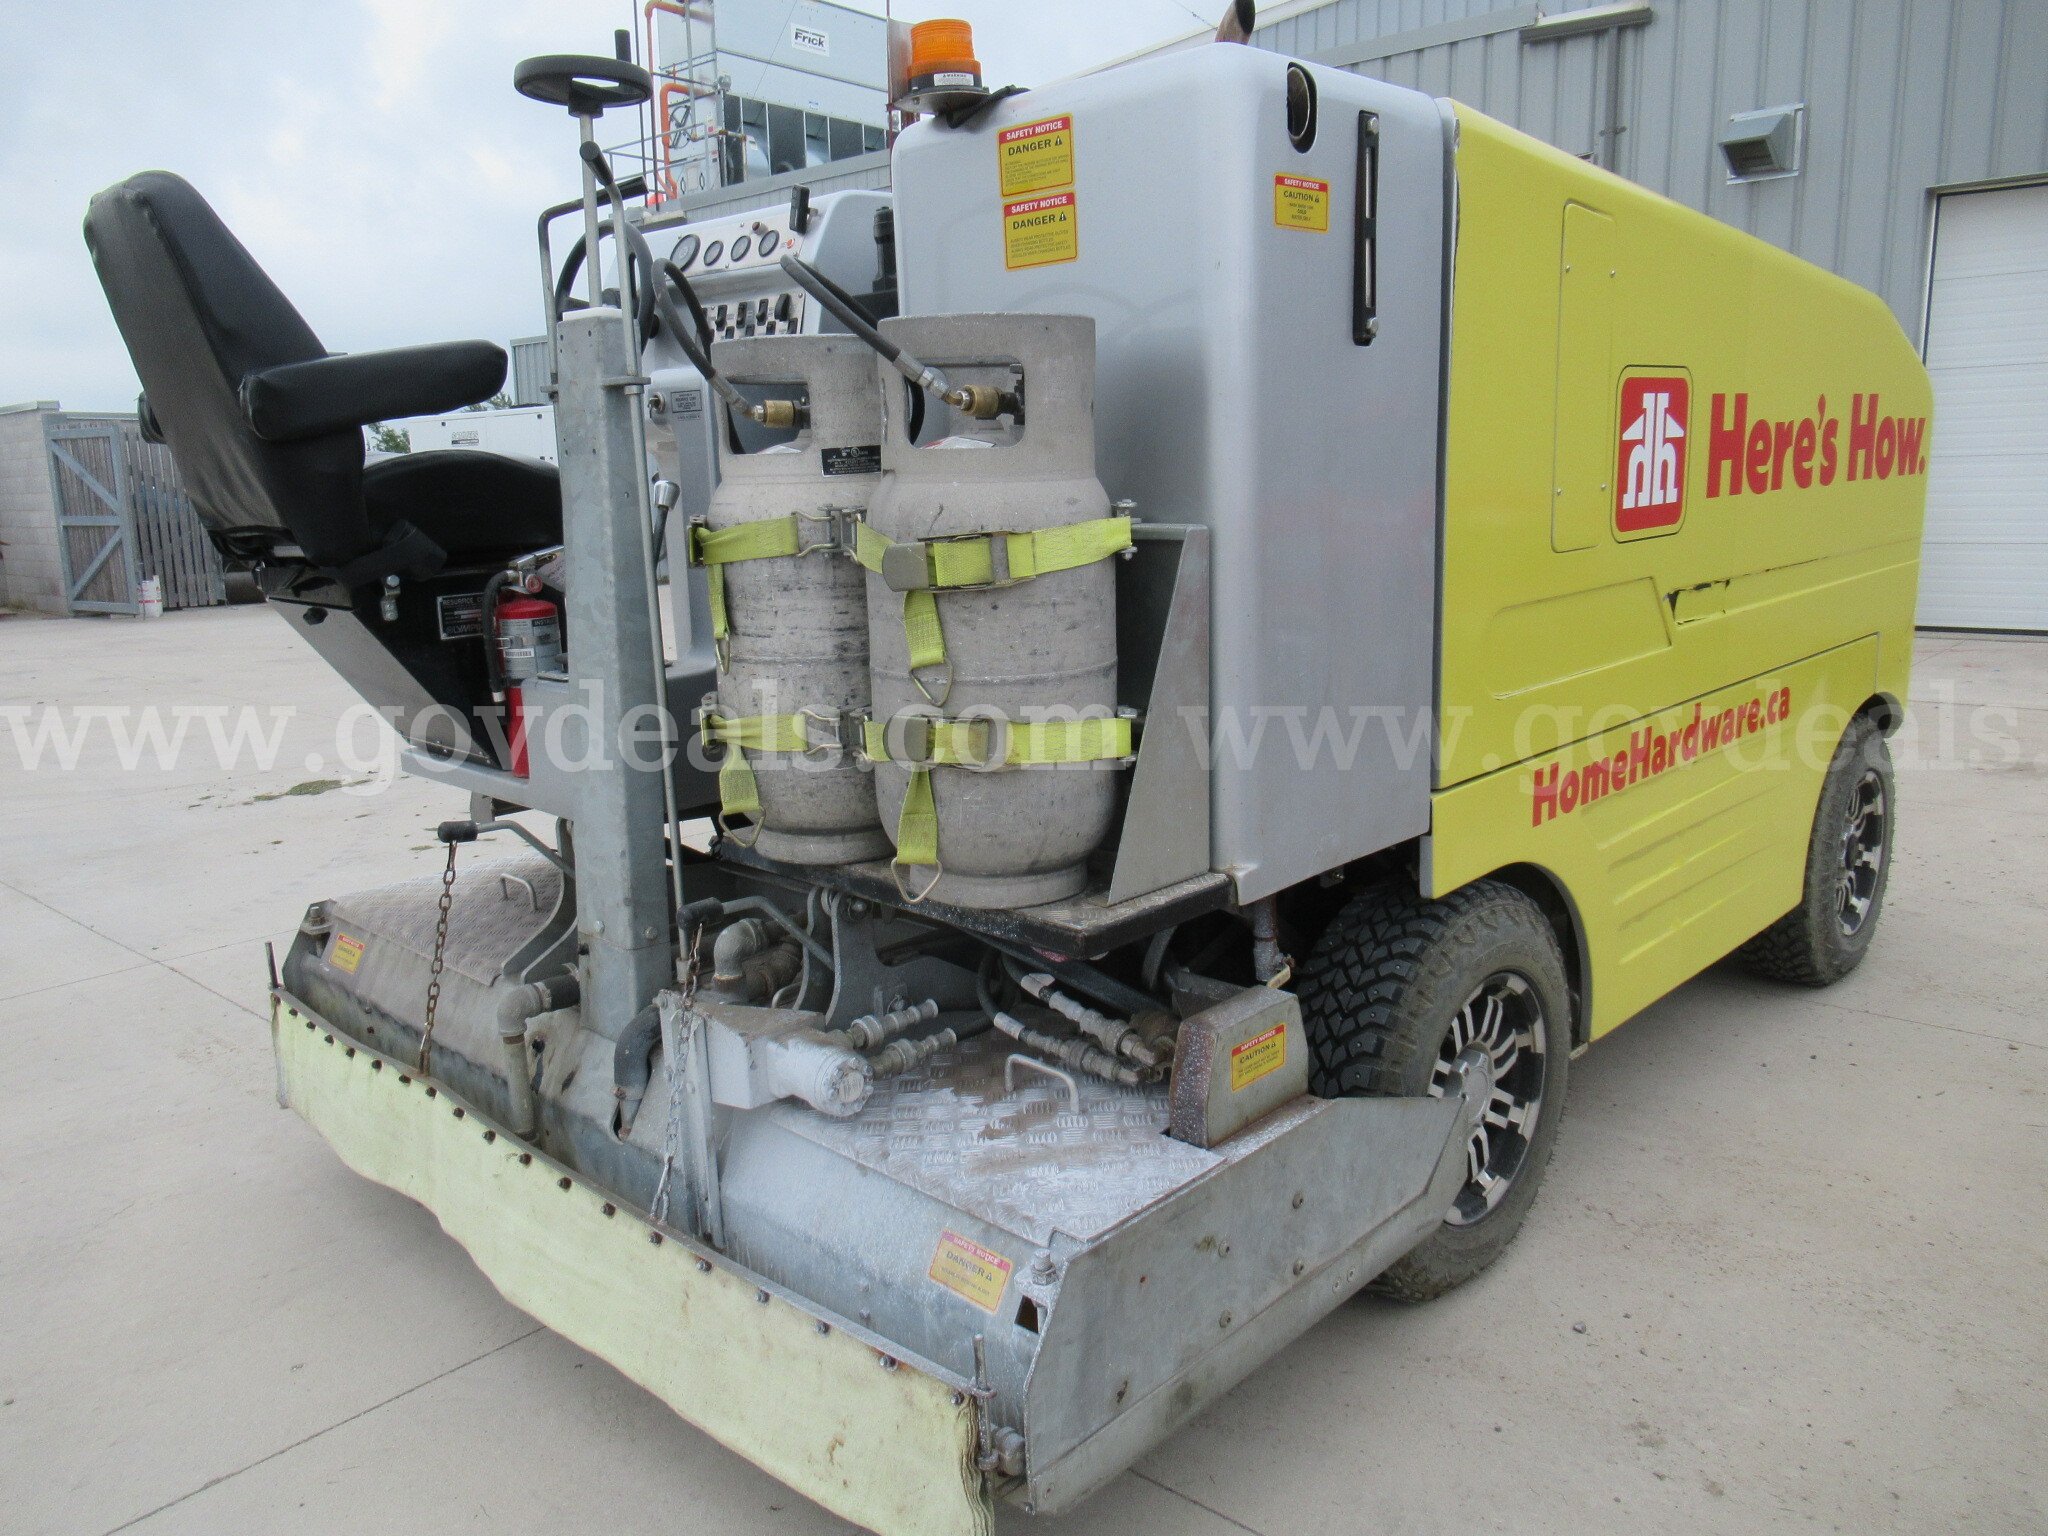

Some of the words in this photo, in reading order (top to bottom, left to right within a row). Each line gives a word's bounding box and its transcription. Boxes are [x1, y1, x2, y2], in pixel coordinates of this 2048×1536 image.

[795, 31, 824, 47] Frick
[1006, 127, 1034, 141] SAFETY
[1035, 120, 1063, 134] NOTICE
[1008, 138, 1052, 156] DANGER
[1284, 178, 1302, 187] SAFETY
[1303, 181, 1319, 189] NOTICE
[1011, 201, 1039, 214] SAFETY
[1040, 195, 1068, 208] NOTICE
[1283, 190, 1314, 202] CAUTION
[1012, 214, 1056, 230] DANGER
[1706, 392, 1838, 499] Here's
[1846, 393, 1926, 482] How.
[1531, 686, 1791, 827] HomeHardware.ca
[1240, 1038, 1258, 1051] SAFETY
[1259, 1029, 1276, 1042] NOTICE
[1240, 1042, 1271, 1064] CAUTION
[954, 1237, 975, 1256] SAFETY
[976, 1248, 1000, 1266] NOTICE
[946, 1250, 986, 1277] DANGER
